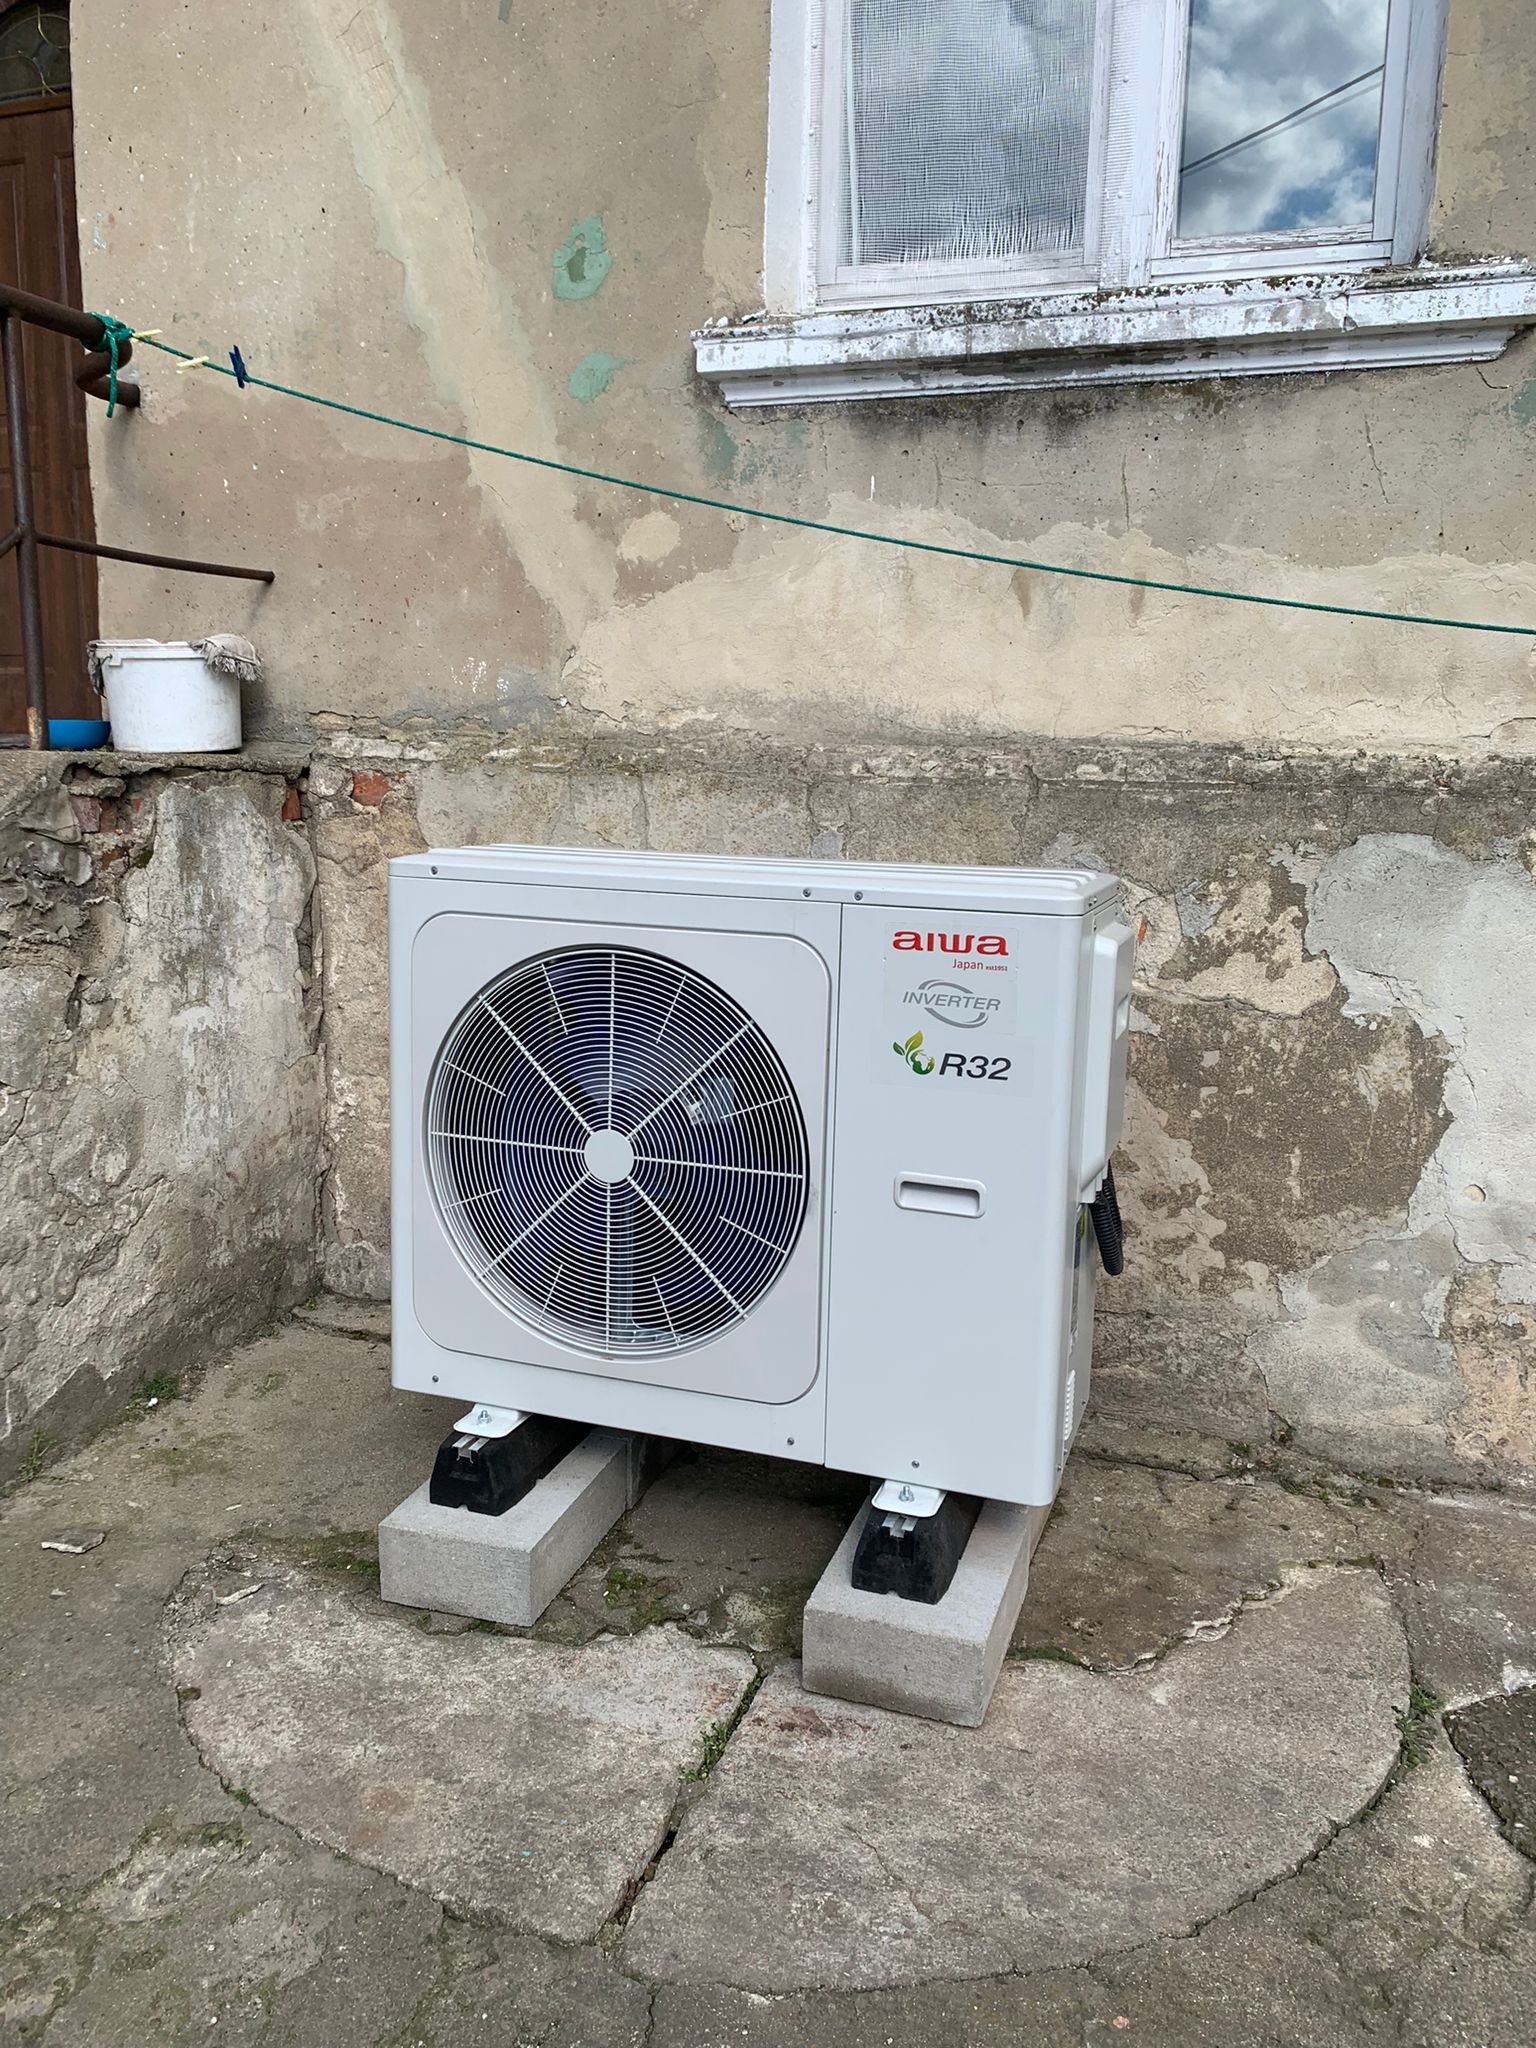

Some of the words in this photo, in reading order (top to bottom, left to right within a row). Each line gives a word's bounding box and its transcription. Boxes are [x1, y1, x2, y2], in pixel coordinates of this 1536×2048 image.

[892, 931, 1009, 956] aiwa
[952, 959, 984, 971] Japan
[902, 990, 1001, 1011] INVERTER
[939, 1053, 1012, 1081] R32
